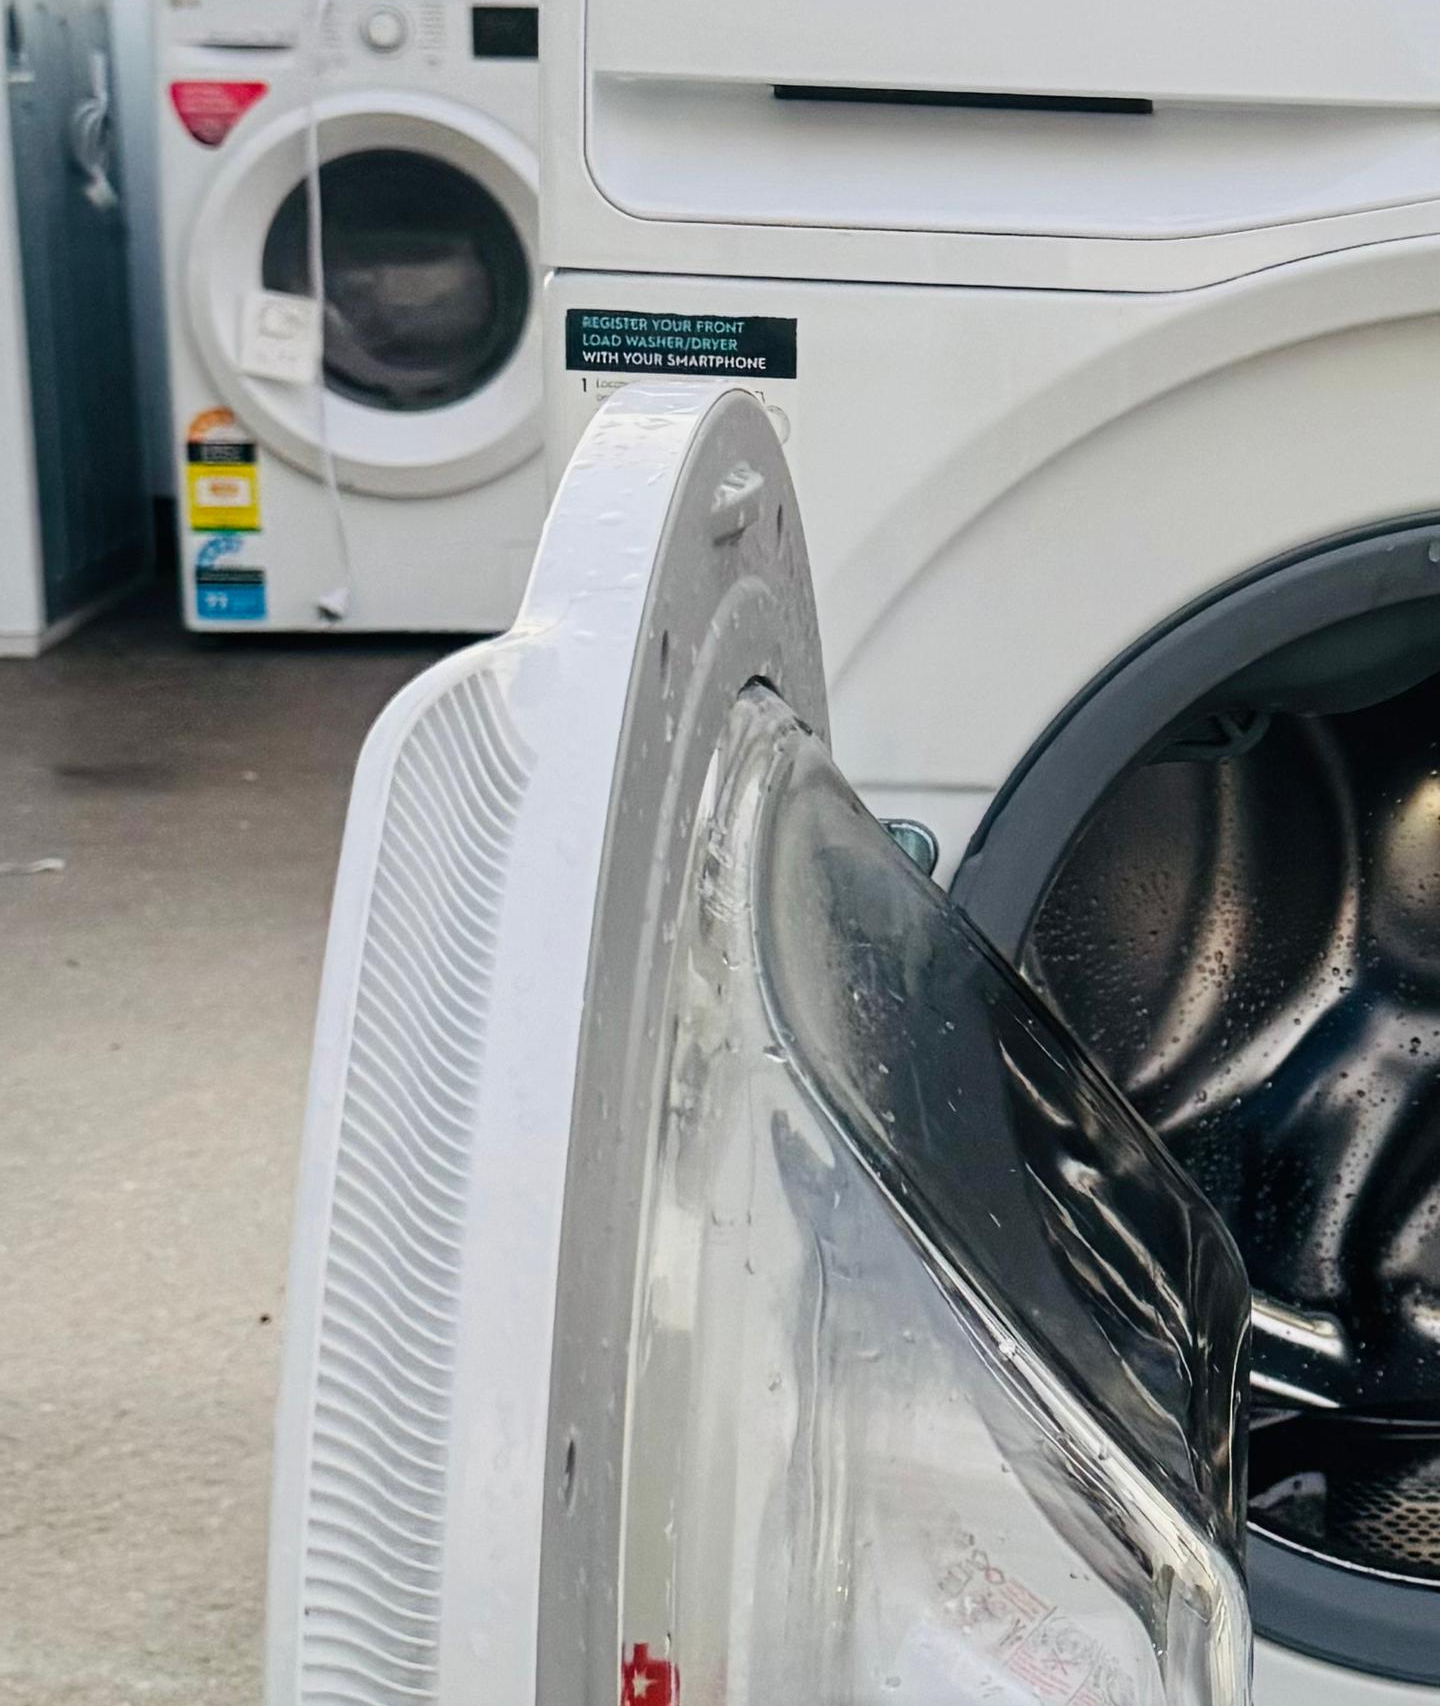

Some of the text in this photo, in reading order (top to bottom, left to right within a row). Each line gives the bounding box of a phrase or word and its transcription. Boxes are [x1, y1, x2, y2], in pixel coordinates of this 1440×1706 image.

[581, 315, 746, 334] REGISTER YOUR FRONT
[582, 334, 738, 351] LOAD WASHER/DRYER
[582, 351, 767, 370] WITH YOUR SMARTPHONE
